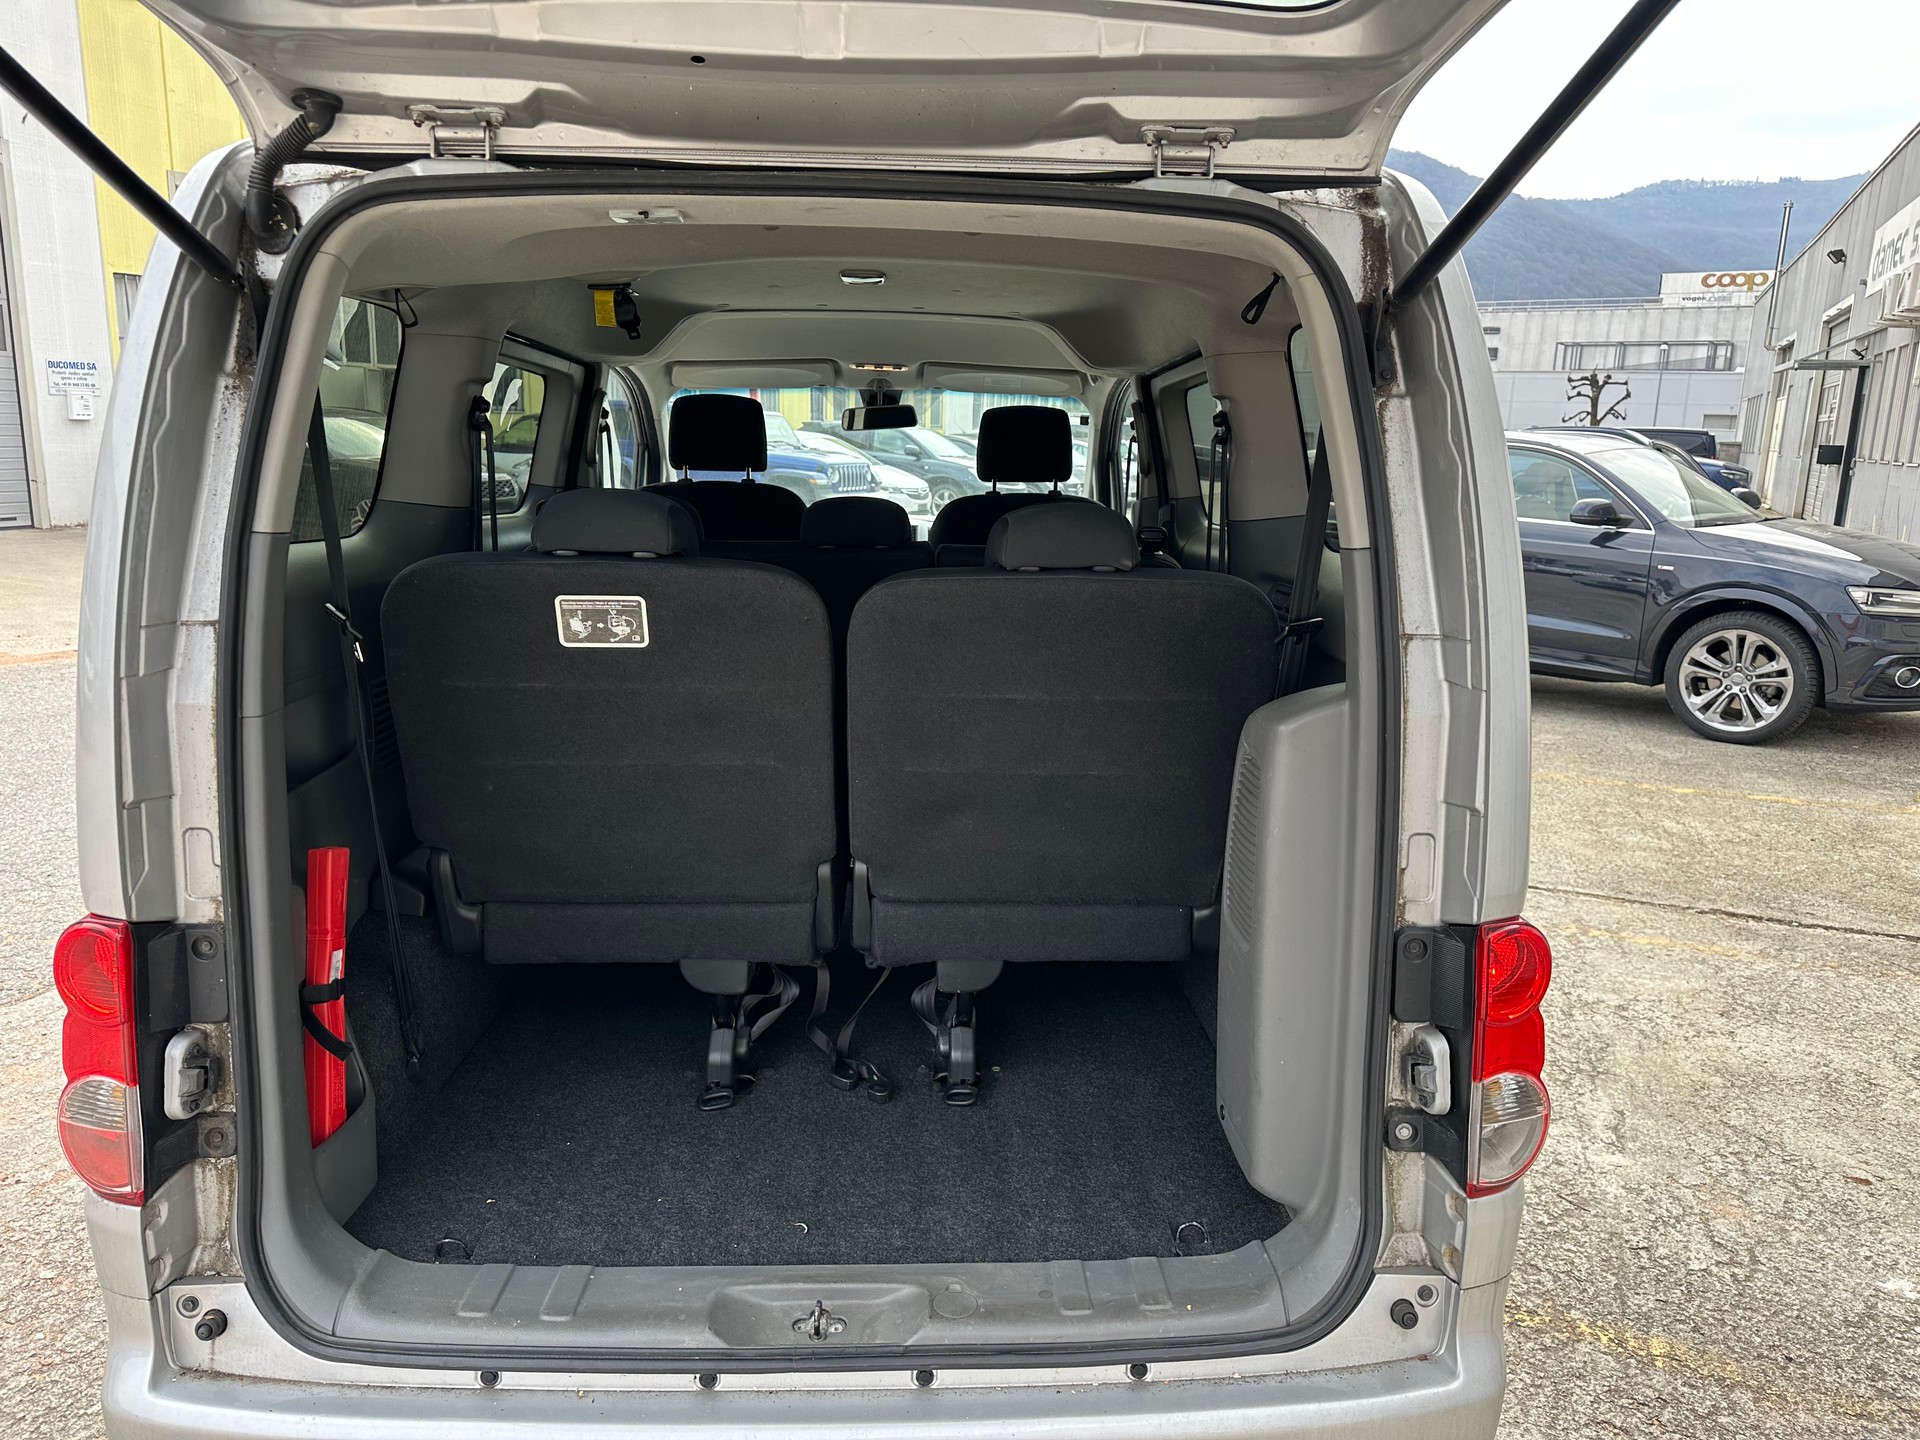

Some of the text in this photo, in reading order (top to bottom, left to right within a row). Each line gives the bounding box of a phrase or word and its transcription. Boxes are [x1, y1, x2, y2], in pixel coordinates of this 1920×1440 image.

[1701, 272, 1769, 292] coop
[48, 360, 97, 371] DUCOMED SA
